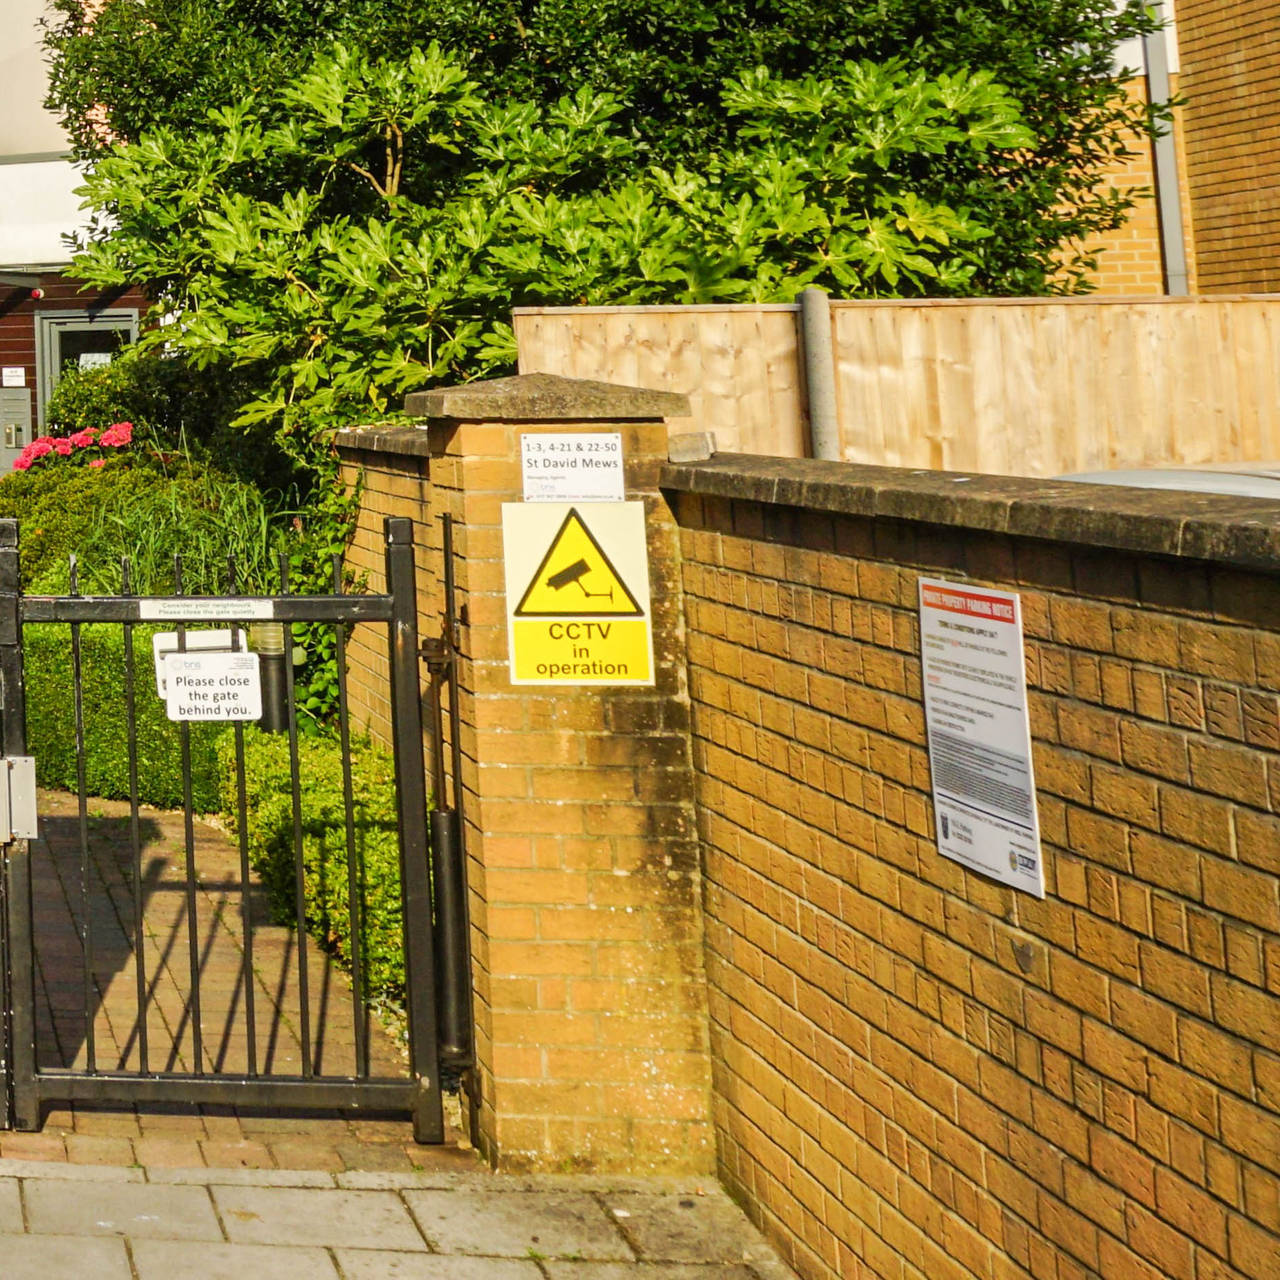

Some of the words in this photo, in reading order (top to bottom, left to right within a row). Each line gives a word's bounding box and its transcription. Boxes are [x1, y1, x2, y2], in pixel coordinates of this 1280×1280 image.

[548, 442, 572, 452] 4-21
[575, 442, 584, 452] &
[587, 442, 617, 452] 22-50
[526, 458, 538, 468] St
[542, 457, 577, 468] David
[582, 458, 618, 468] Mews
[548, 622, 611, 640] CCTV
[572, 643, 589, 658] in
[536, 659, 628, 678] operation
[175, 676, 215, 687] Please
[218, 675, 250, 686] close
[188, 690, 209, 701] the
[213, 691, 239, 703] gate
[178, 705, 221, 716] behind
[225, 706, 252, 717] you.
